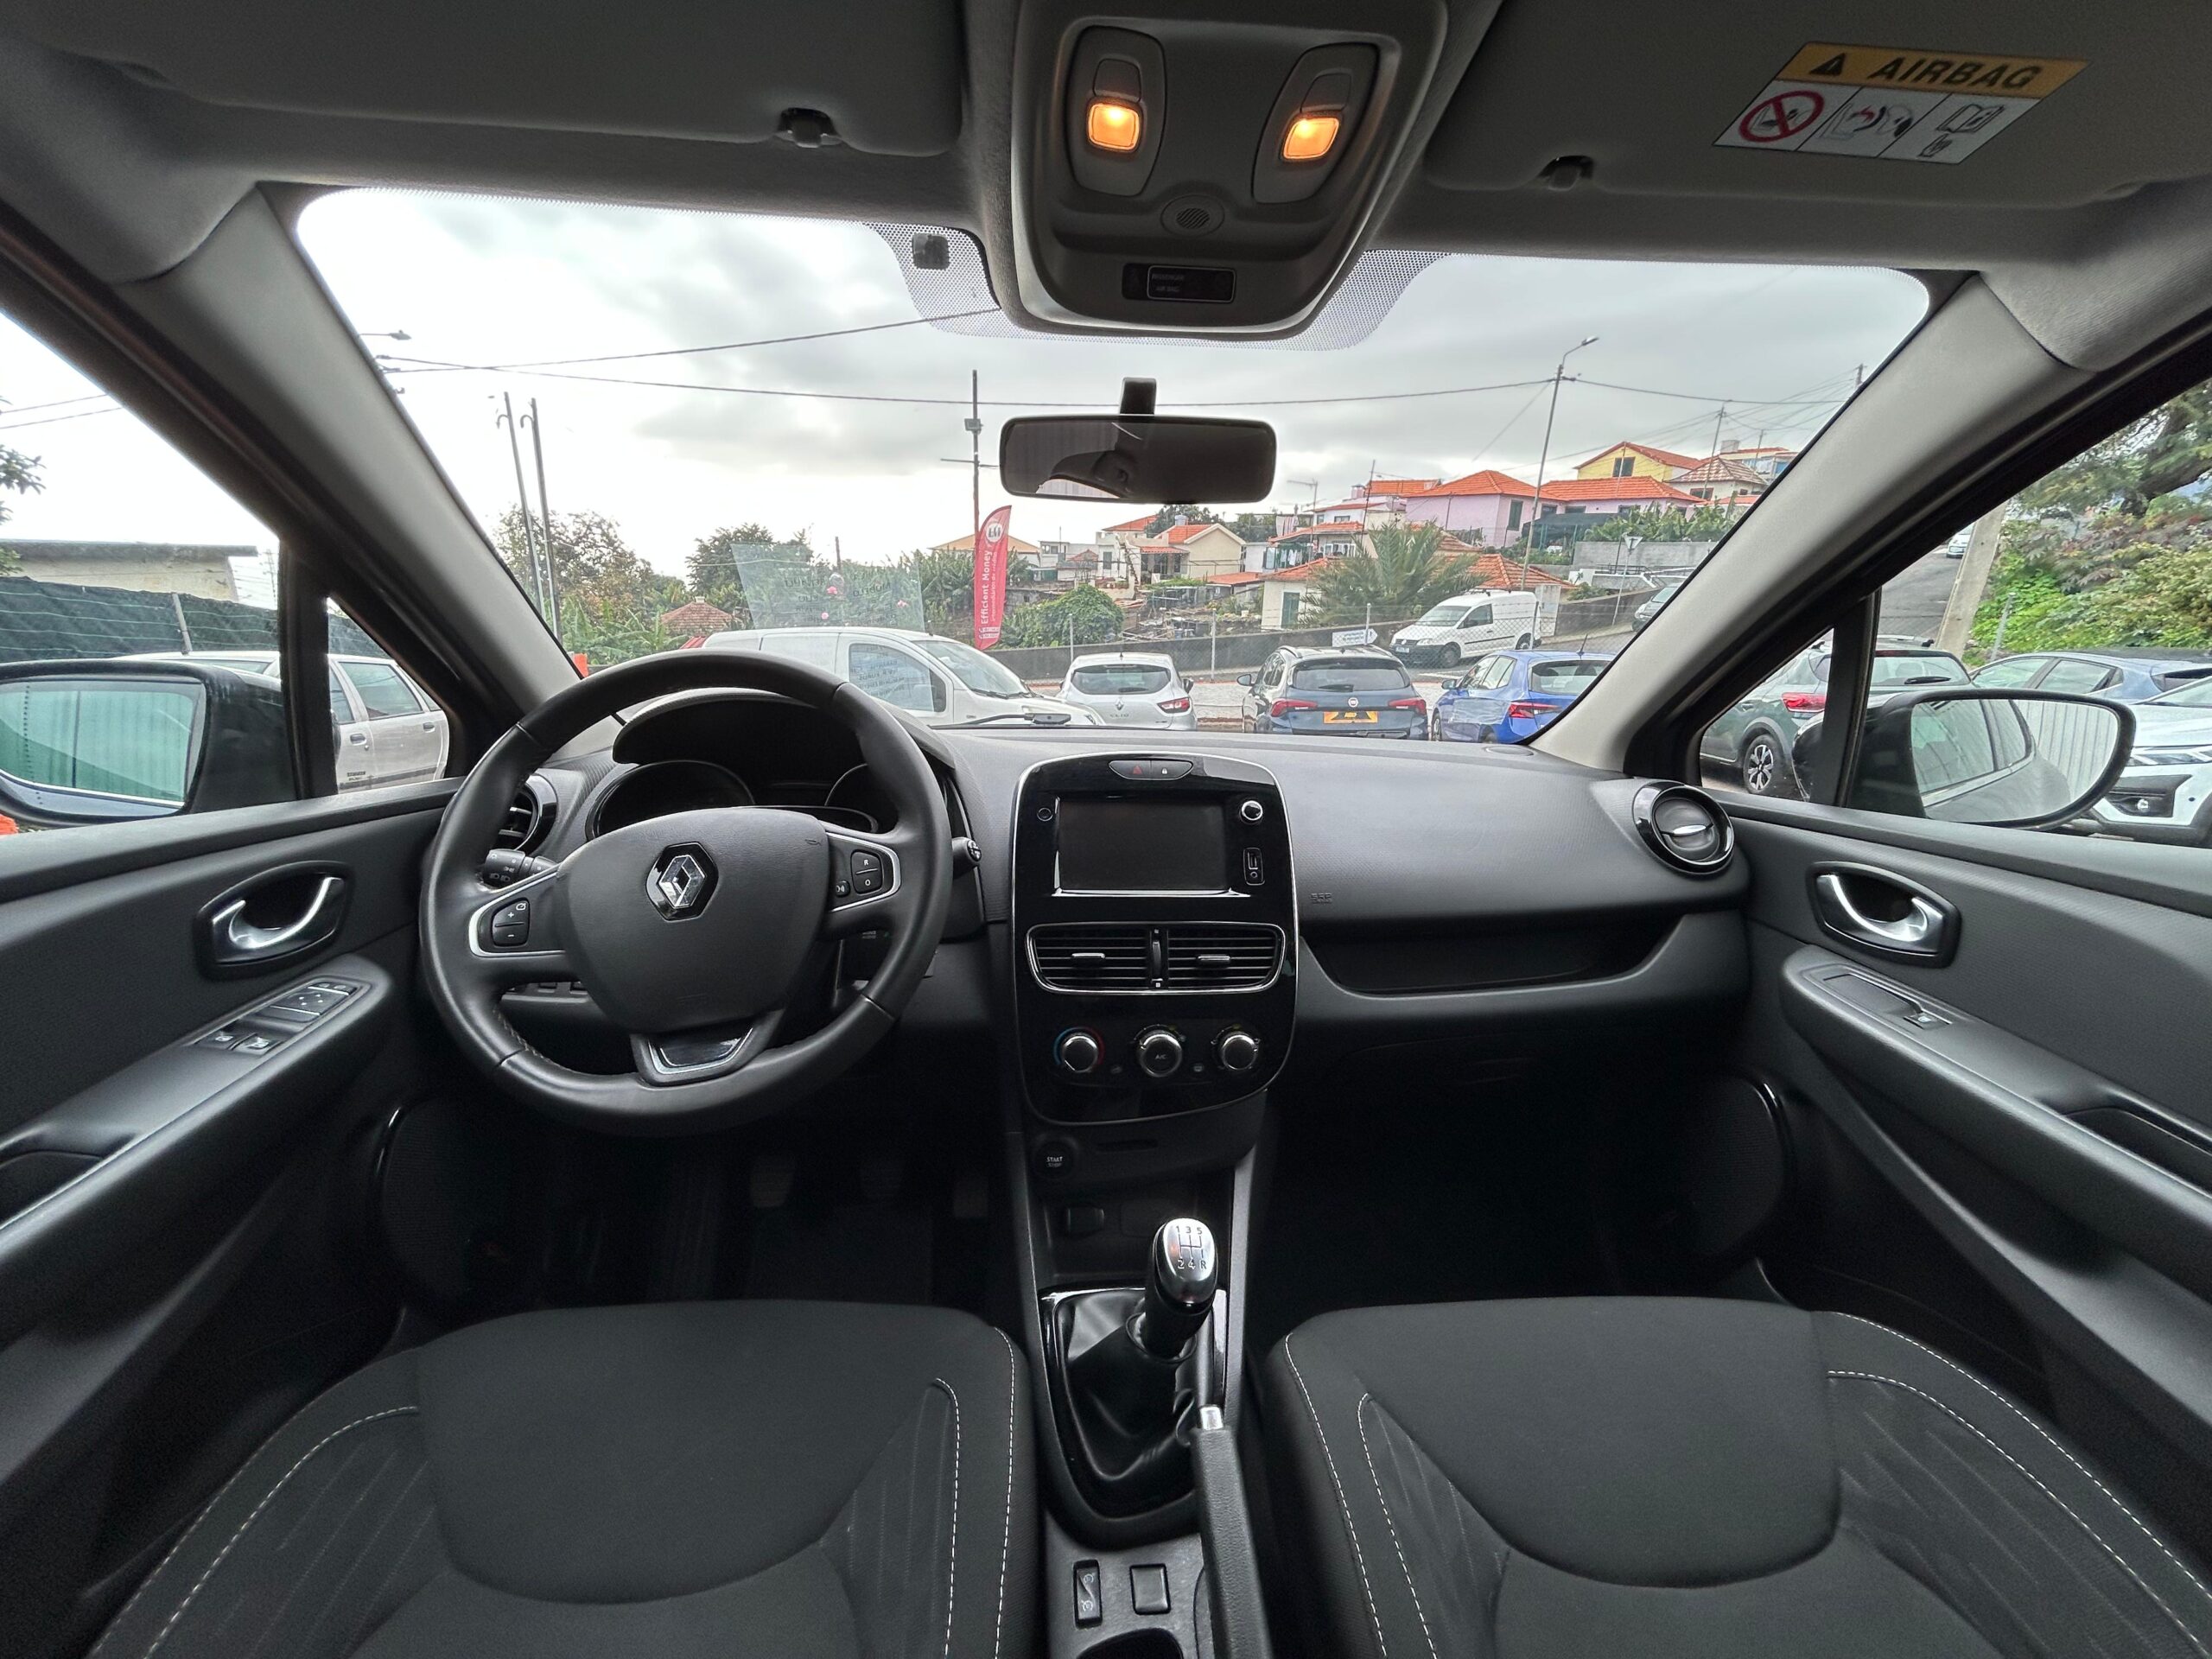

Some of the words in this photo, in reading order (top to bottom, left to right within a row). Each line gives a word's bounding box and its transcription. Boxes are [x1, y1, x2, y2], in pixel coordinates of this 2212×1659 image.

[1867, 57, 2044, 87] AIRBAG
[982, 550, 993, 582] Money
[981, 584, 989, 624] Efficient
[1177, 1258, 1185, 1269] 2
[1187, 1258, 1196, 1269] 4
[1200, 1260, 1207, 1269] R
